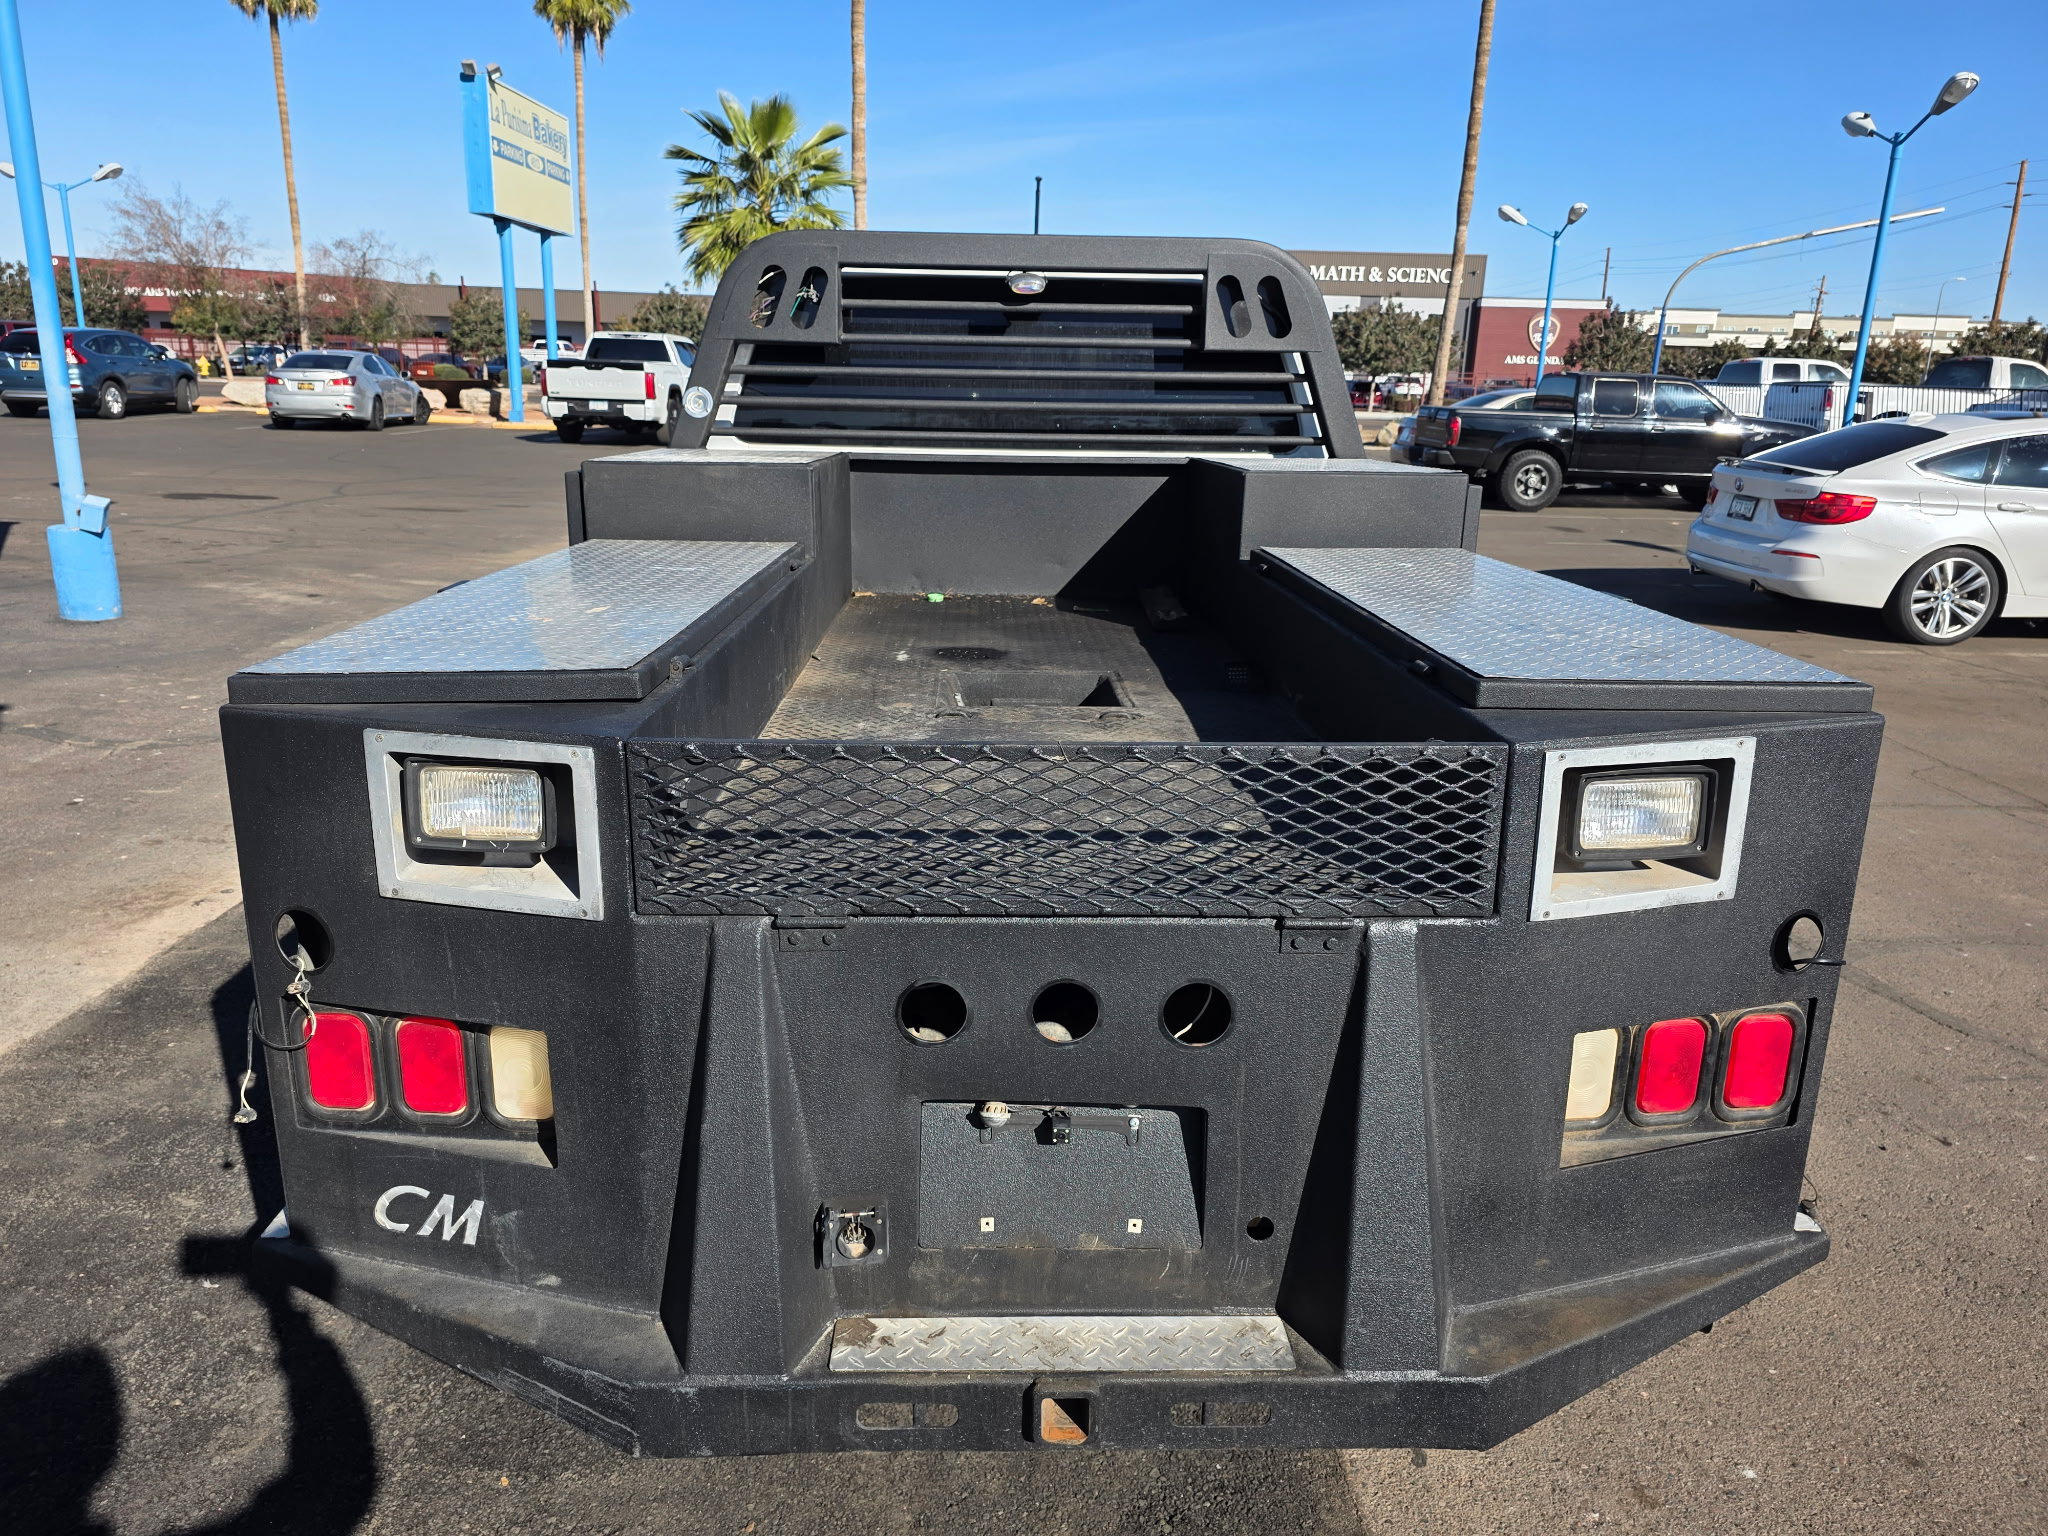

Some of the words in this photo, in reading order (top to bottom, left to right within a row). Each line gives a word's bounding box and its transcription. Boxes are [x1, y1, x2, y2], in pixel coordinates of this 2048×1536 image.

[489, 93, 501, 124] La
[531, 112, 568, 163] Bakery
[1310, 264, 1365, 282] MATH
[1368, 266, 1383, 282] &
[1386, 266, 1463, 284] SCIENC
[1504, 354, 1526, 365] AMS
[374, 1185, 485, 1246] CM
